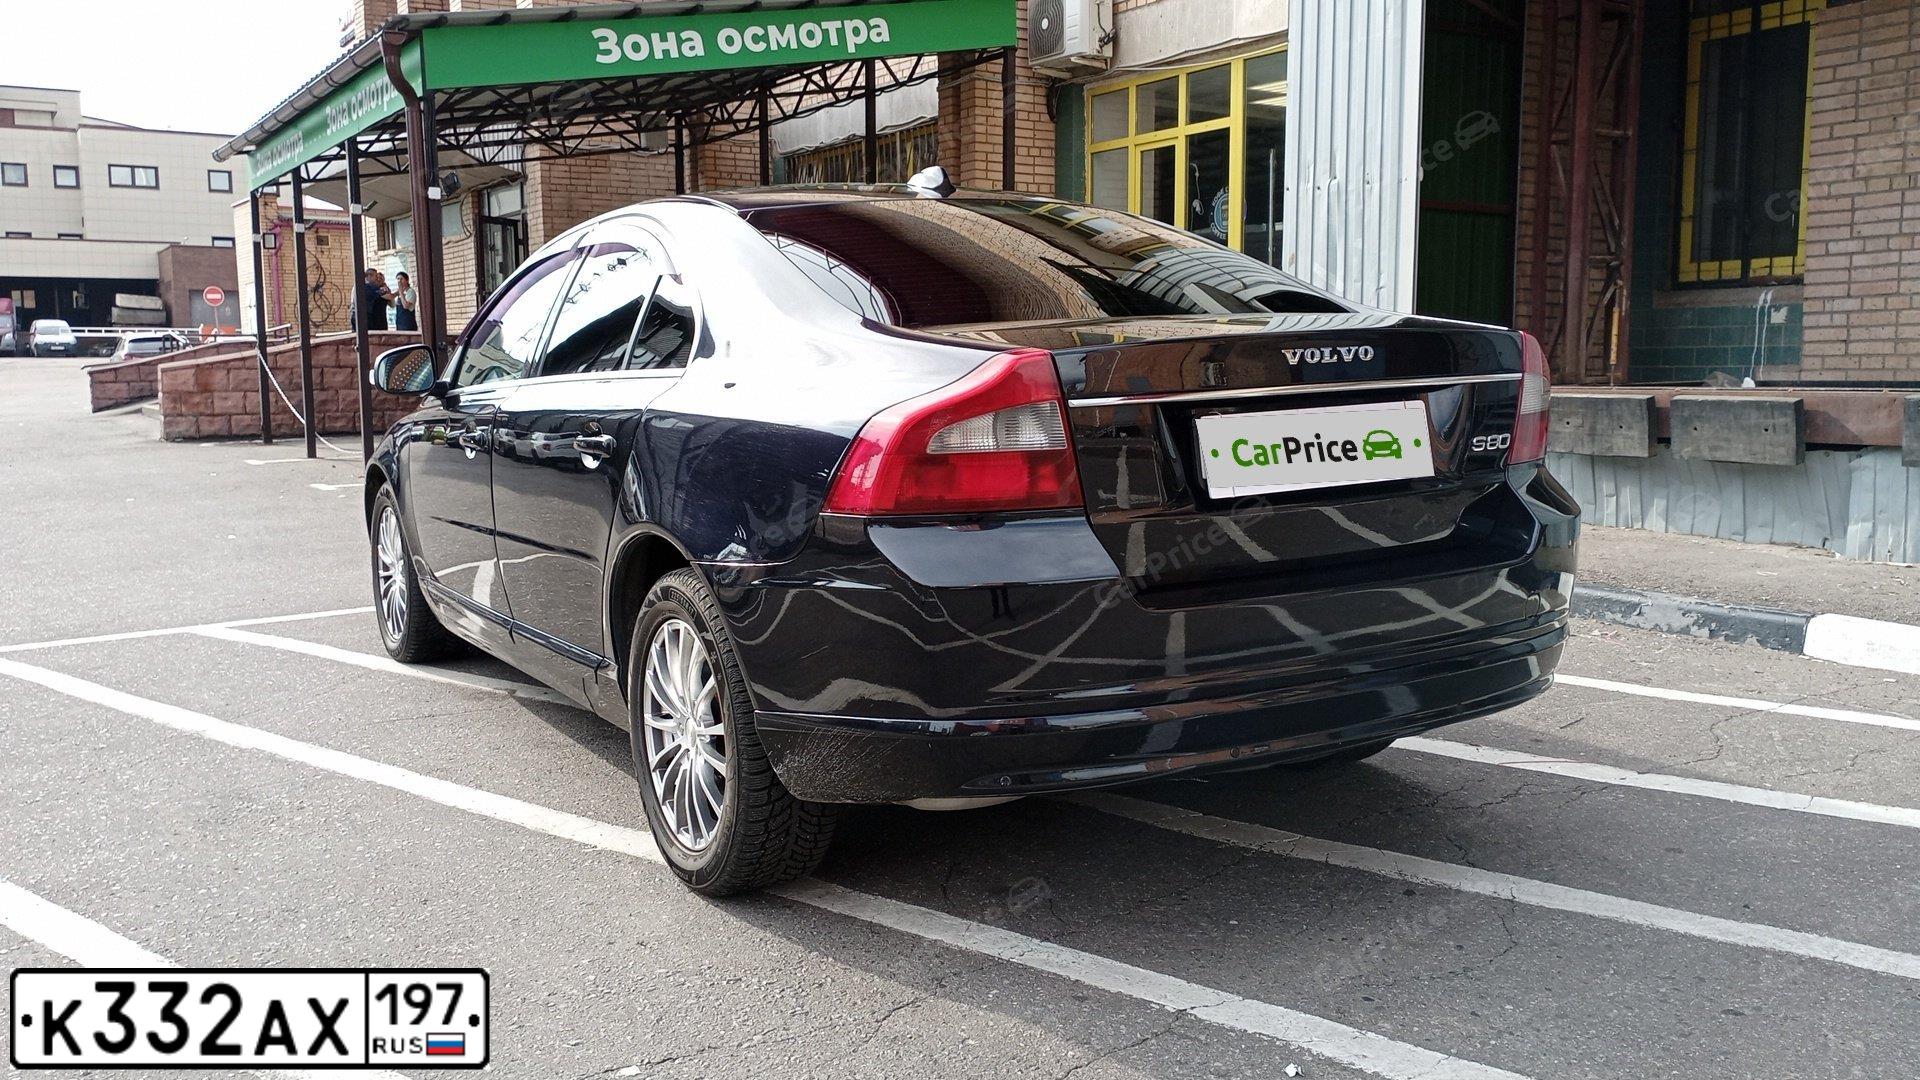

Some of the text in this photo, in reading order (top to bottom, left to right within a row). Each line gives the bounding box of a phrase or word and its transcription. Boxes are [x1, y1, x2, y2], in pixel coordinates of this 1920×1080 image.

[591, 17, 890, 64] Зона осмотра
[325, 105, 349, 136] Зона
[1282, 345, 1375, 366] VOLVO
[1472, 433, 1511, 452] S80
